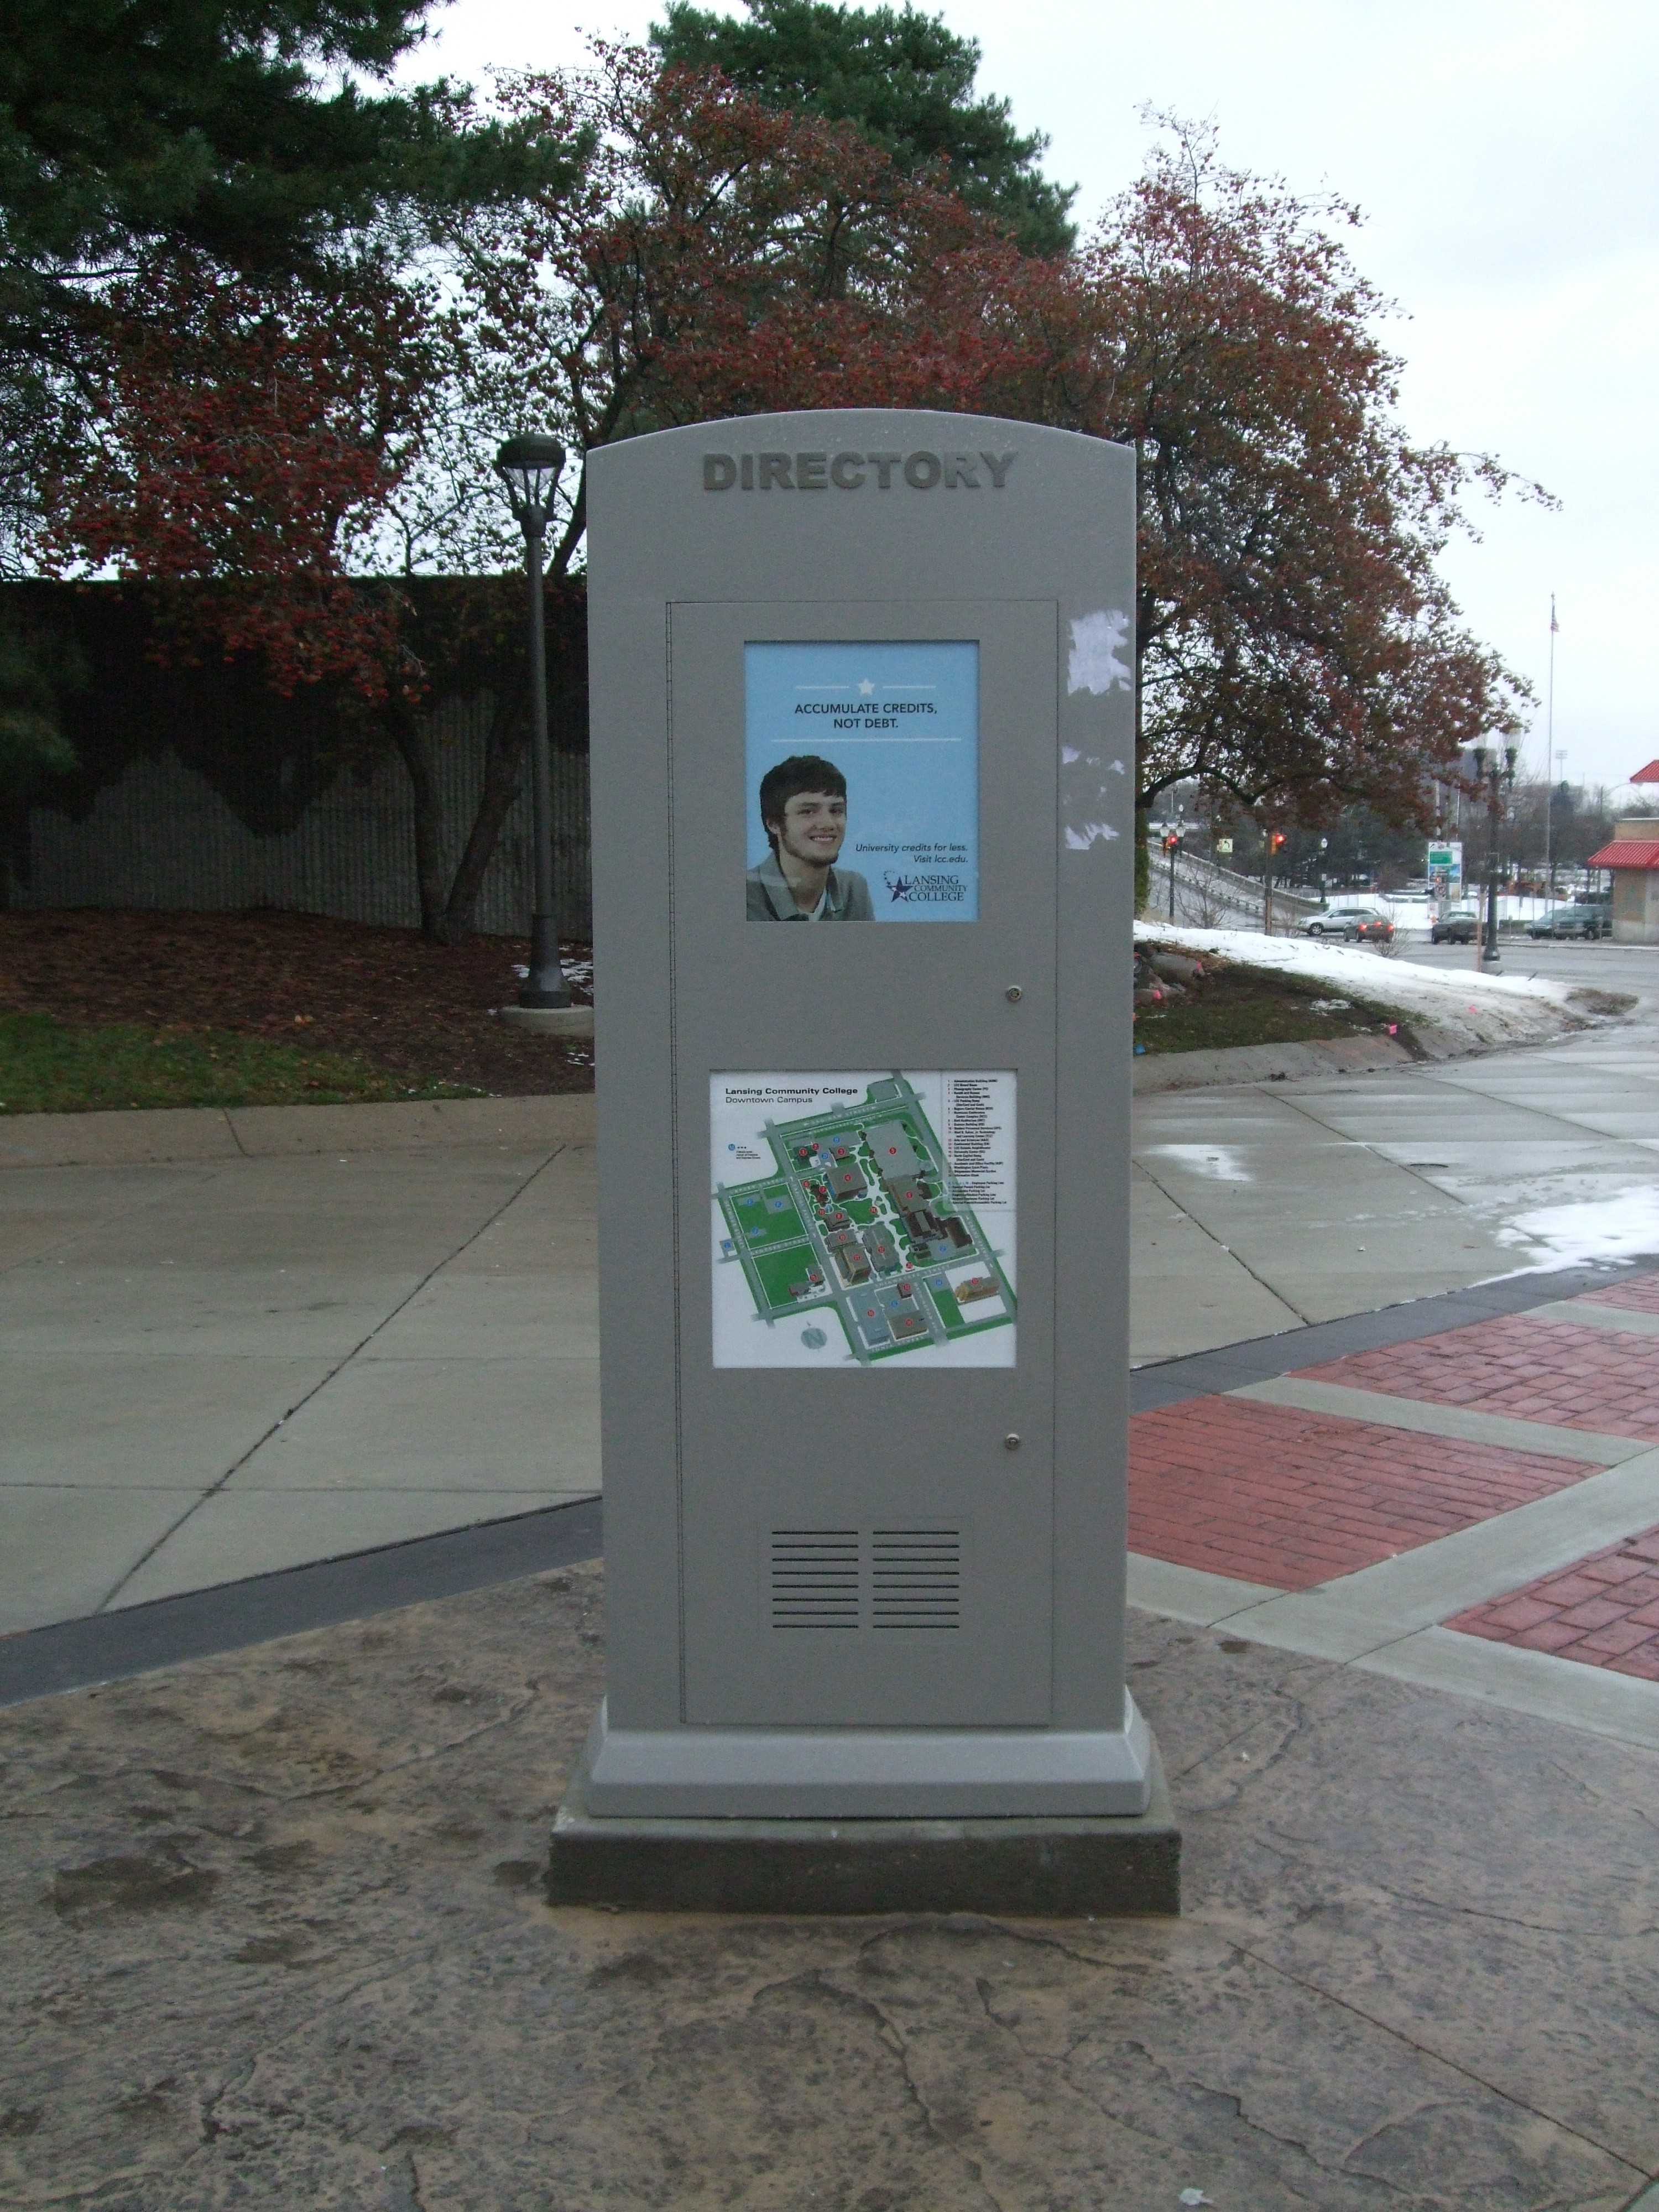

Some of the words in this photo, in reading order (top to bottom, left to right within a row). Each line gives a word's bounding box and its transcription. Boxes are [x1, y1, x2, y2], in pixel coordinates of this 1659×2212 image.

[702, 451, 1018, 491] DIRECTORY
[795, 703, 879, 714] ACCUMULATE
[883, 703, 937, 714] CREDITS,
[833, 718, 860, 728] NOT
[864, 718, 899, 728] DEBT.
[855, 843, 899, 853] University
[901, 843, 931, 852] credits
[934, 843, 947, 852] for
[950, 843, 968, 852] less.
[914, 855, 931, 863] Visit
[935, 855, 968, 863] lcc.edu.
[904, 875, 959, 885] LANSING
[909, 892, 964, 901] COLLEGE
